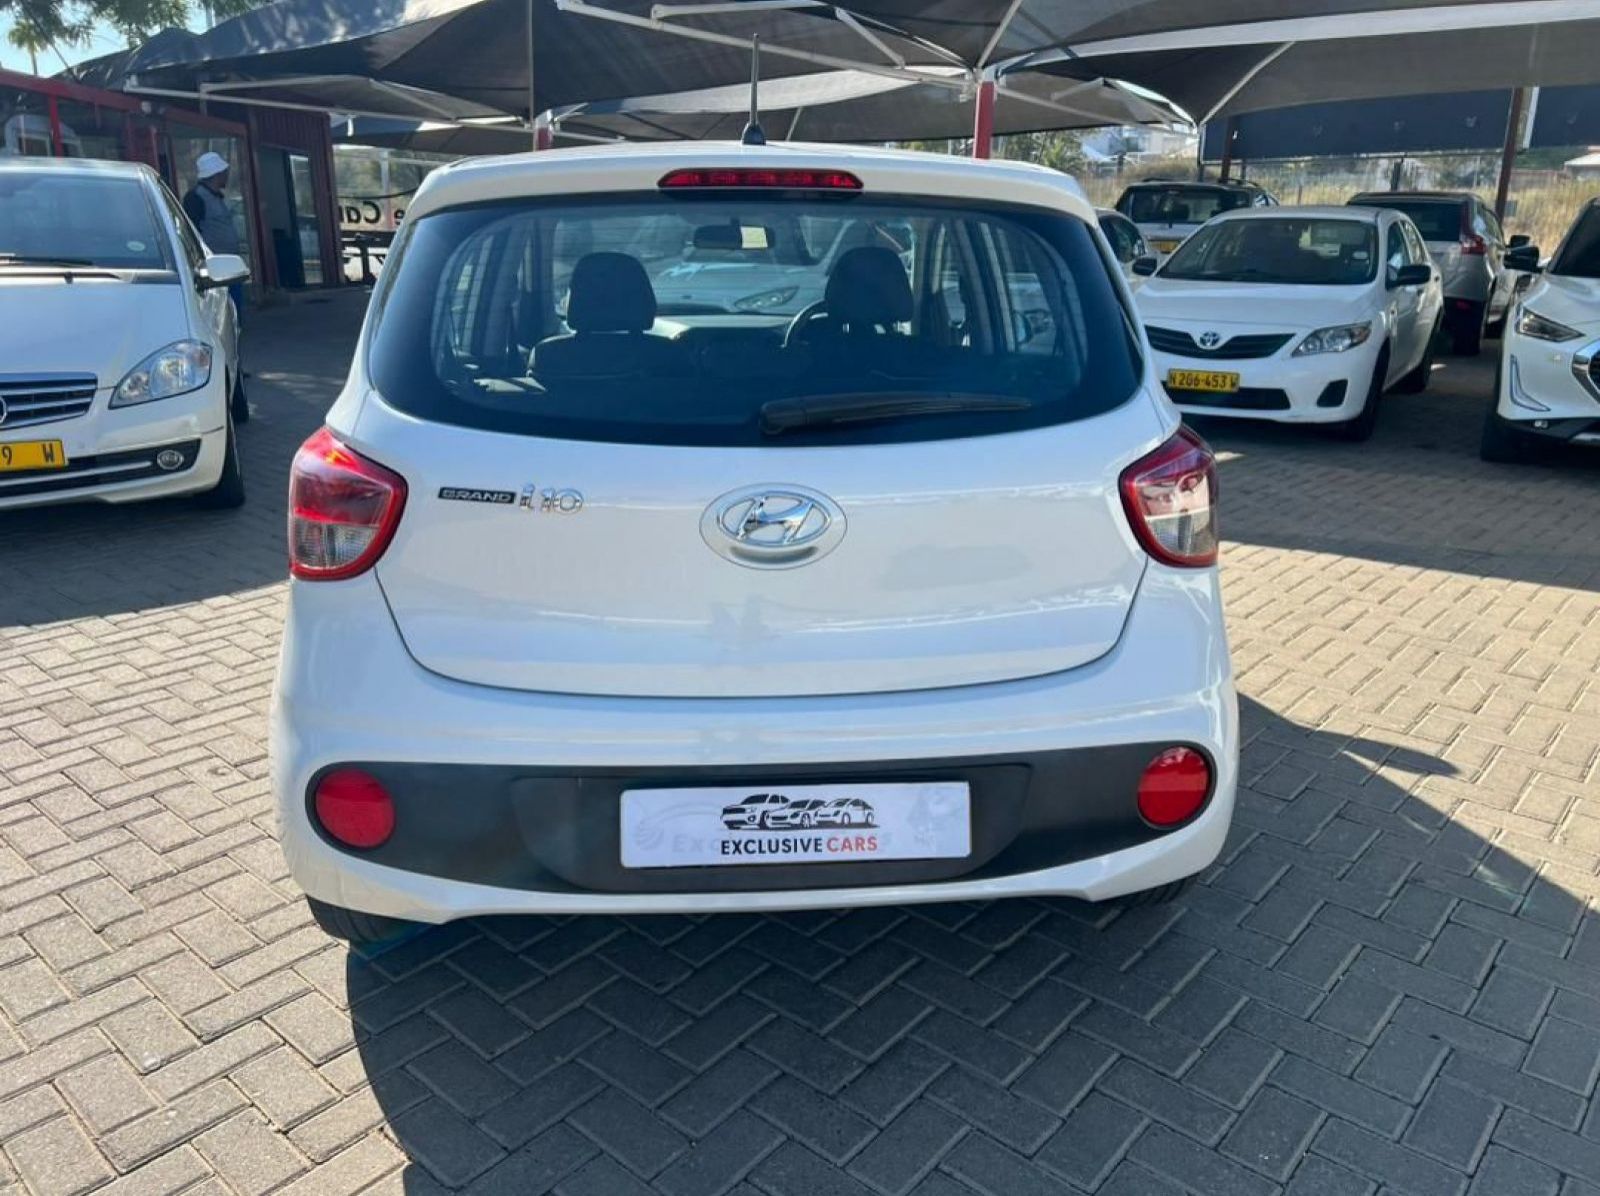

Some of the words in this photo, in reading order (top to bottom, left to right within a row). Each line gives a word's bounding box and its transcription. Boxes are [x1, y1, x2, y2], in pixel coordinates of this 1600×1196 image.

[42, 443, 55, 462] W
[440, 488, 513, 504] GRAND
[720, 837, 823, 855] EXCLUSIVE
[826, 836, 878, 853] CARS
